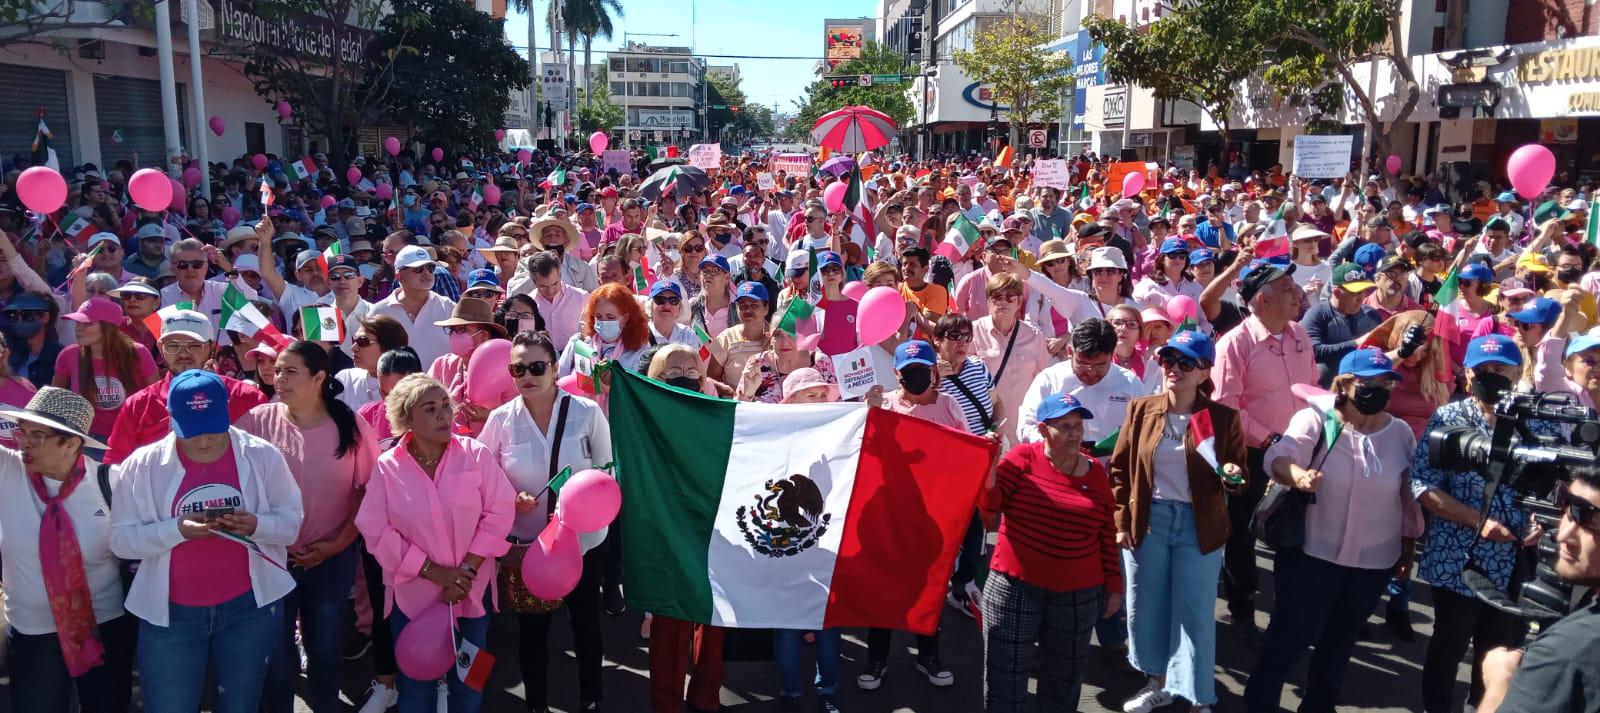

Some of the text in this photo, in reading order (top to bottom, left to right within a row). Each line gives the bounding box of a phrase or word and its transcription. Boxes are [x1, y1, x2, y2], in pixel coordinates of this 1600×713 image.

[221, 0, 280, 47] Nacional
[1082, 49, 1093, 61] LAS
[1076, 62, 1098, 75] MEJORES
[1076, 76, 1097, 89] MARCAS
[1103, 94, 1124, 118] OXXO
[852, 376, 874, 388] MÉXICO
[181, 495, 241, 513] #ELINENO
